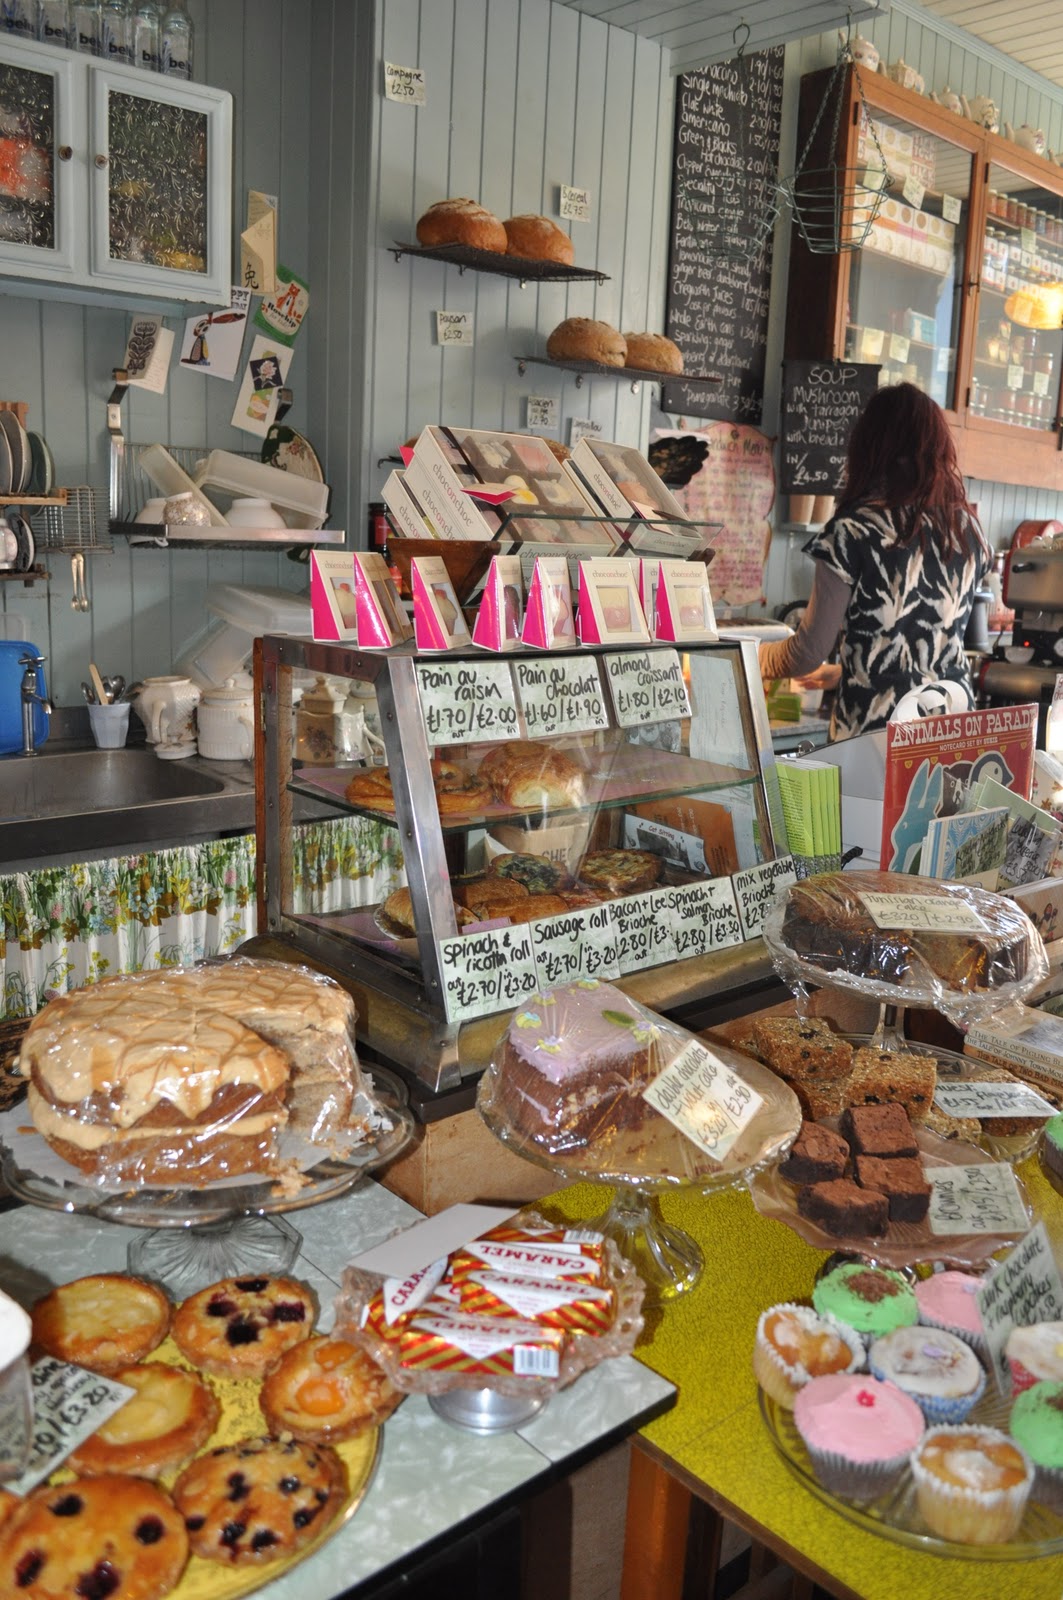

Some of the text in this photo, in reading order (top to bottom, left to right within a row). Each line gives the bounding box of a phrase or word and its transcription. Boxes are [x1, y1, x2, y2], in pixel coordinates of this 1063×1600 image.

[683, 73, 711, 101] Single
[679, 126, 705, 147] Green
[267, 301, 298, 328] Rosehip
[694, 315, 718, 334] Earth
[807, 367, 858, 385] SOUP
[792, 385, 861, 404] Mushroom
[786, 402, 860, 416] with tarragon
[786, 430, 807, 444] with
[808, 432, 838, 446] bread
[792, 465, 829, 486] £4.50
[432, 463, 474, 528] choconchoc
[593, 472, 622, 510] choconchoc
[654, 537, 690, 549] choconchoc
[592, 569, 629, 579] choconchoc
[671, 570, 703, 578] choconchoc
[518, 663, 566, 688] Pain au
[610, 652, 651, 676] almond
[636, 664, 680, 687] croissant
[421, 668, 477, 690] Pain au
[454, 676, 502, 701] raisin
[545, 674, 599, 701] chocolat
[890, 717, 963, 748] ANIMALS
[965, 714, 983, 737] ON
[939, 742, 966, 752] NOTECARD
[966, 740, 976, 749] SET
[976, 739, 983, 747] BY
[736, 873, 757, 892] mix
[758, 859, 795, 884] vegetable
[667, 886, 708, 914] Spinach
[741, 882, 777, 907] Brioche
[608, 900, 641, 922] Bacon
[680, 901, 714, 920] salmon
[701, 902, 737, 926] Brioche
[896, 904, 928, 912] cake
[533, 909, 609, 945] Sausage roll
[617, 913, 659, 934] Brioche
[443, 933, 499, 968] Spinach
[466, 939, 531, 973] ricotta roll
[634, 948, 648, 961] out
[694, 944, 707, 956] out
[967, 1035, 977, 1045] THE
[979, 1042, 993, 1051] TALE
[1003, 1050, 1027, 1065] JOHNNY
[974, 1030, 1051, 1063] THE TALE OF PIGLING
[655, 1046, 709, 1110] double chocolate
[699, 1063, 718, 1088] cake
[977, 1050, 990, 1060] THE
[992, 1055, 1008, 1067] TALE
[1020, 1065, 1034, 1077] TWO
[1034, 1072, 1050, 1083] BAD
[479, 1244, 586, 1269] CARAMEL
[1003, 1236, 1044, 1288] chocolate
[479, 1273, 590, 1296] CARAMEL
